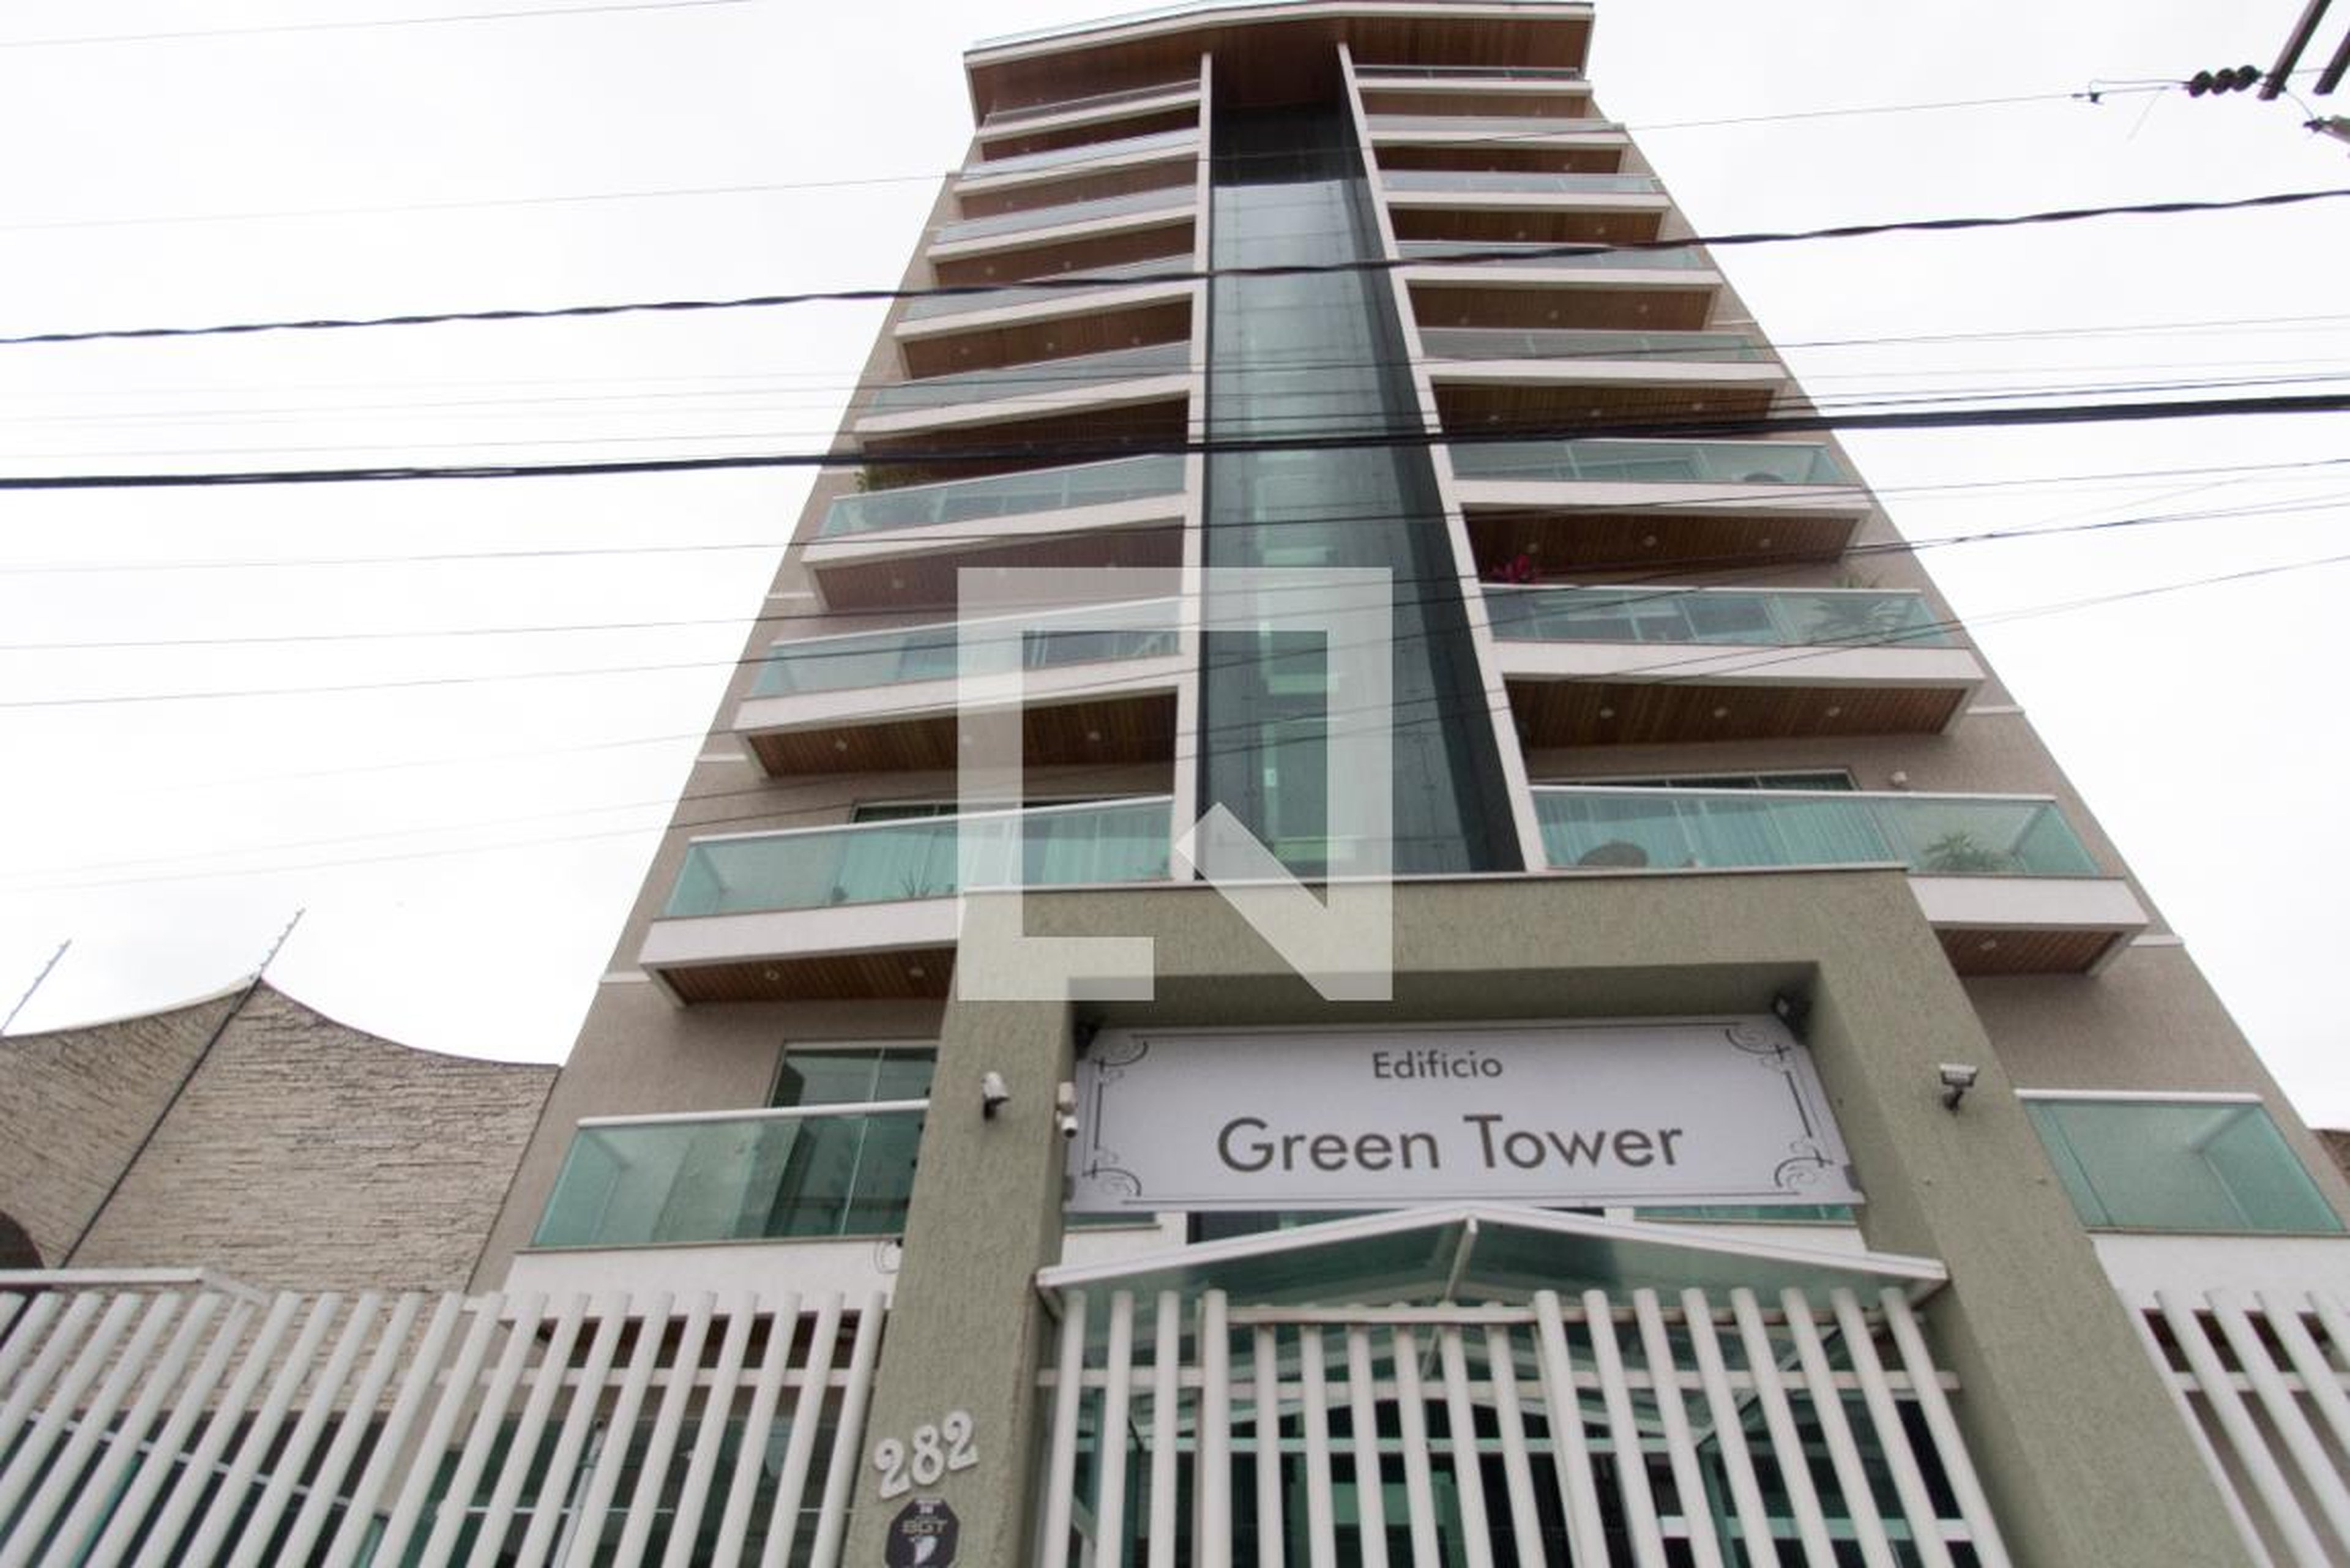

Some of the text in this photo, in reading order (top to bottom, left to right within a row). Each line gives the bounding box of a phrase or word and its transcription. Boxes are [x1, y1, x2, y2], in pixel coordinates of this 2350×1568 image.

[1217, 1114, 1684, 1173] Green Tower
[873, 1409, 979, 1499] 282
